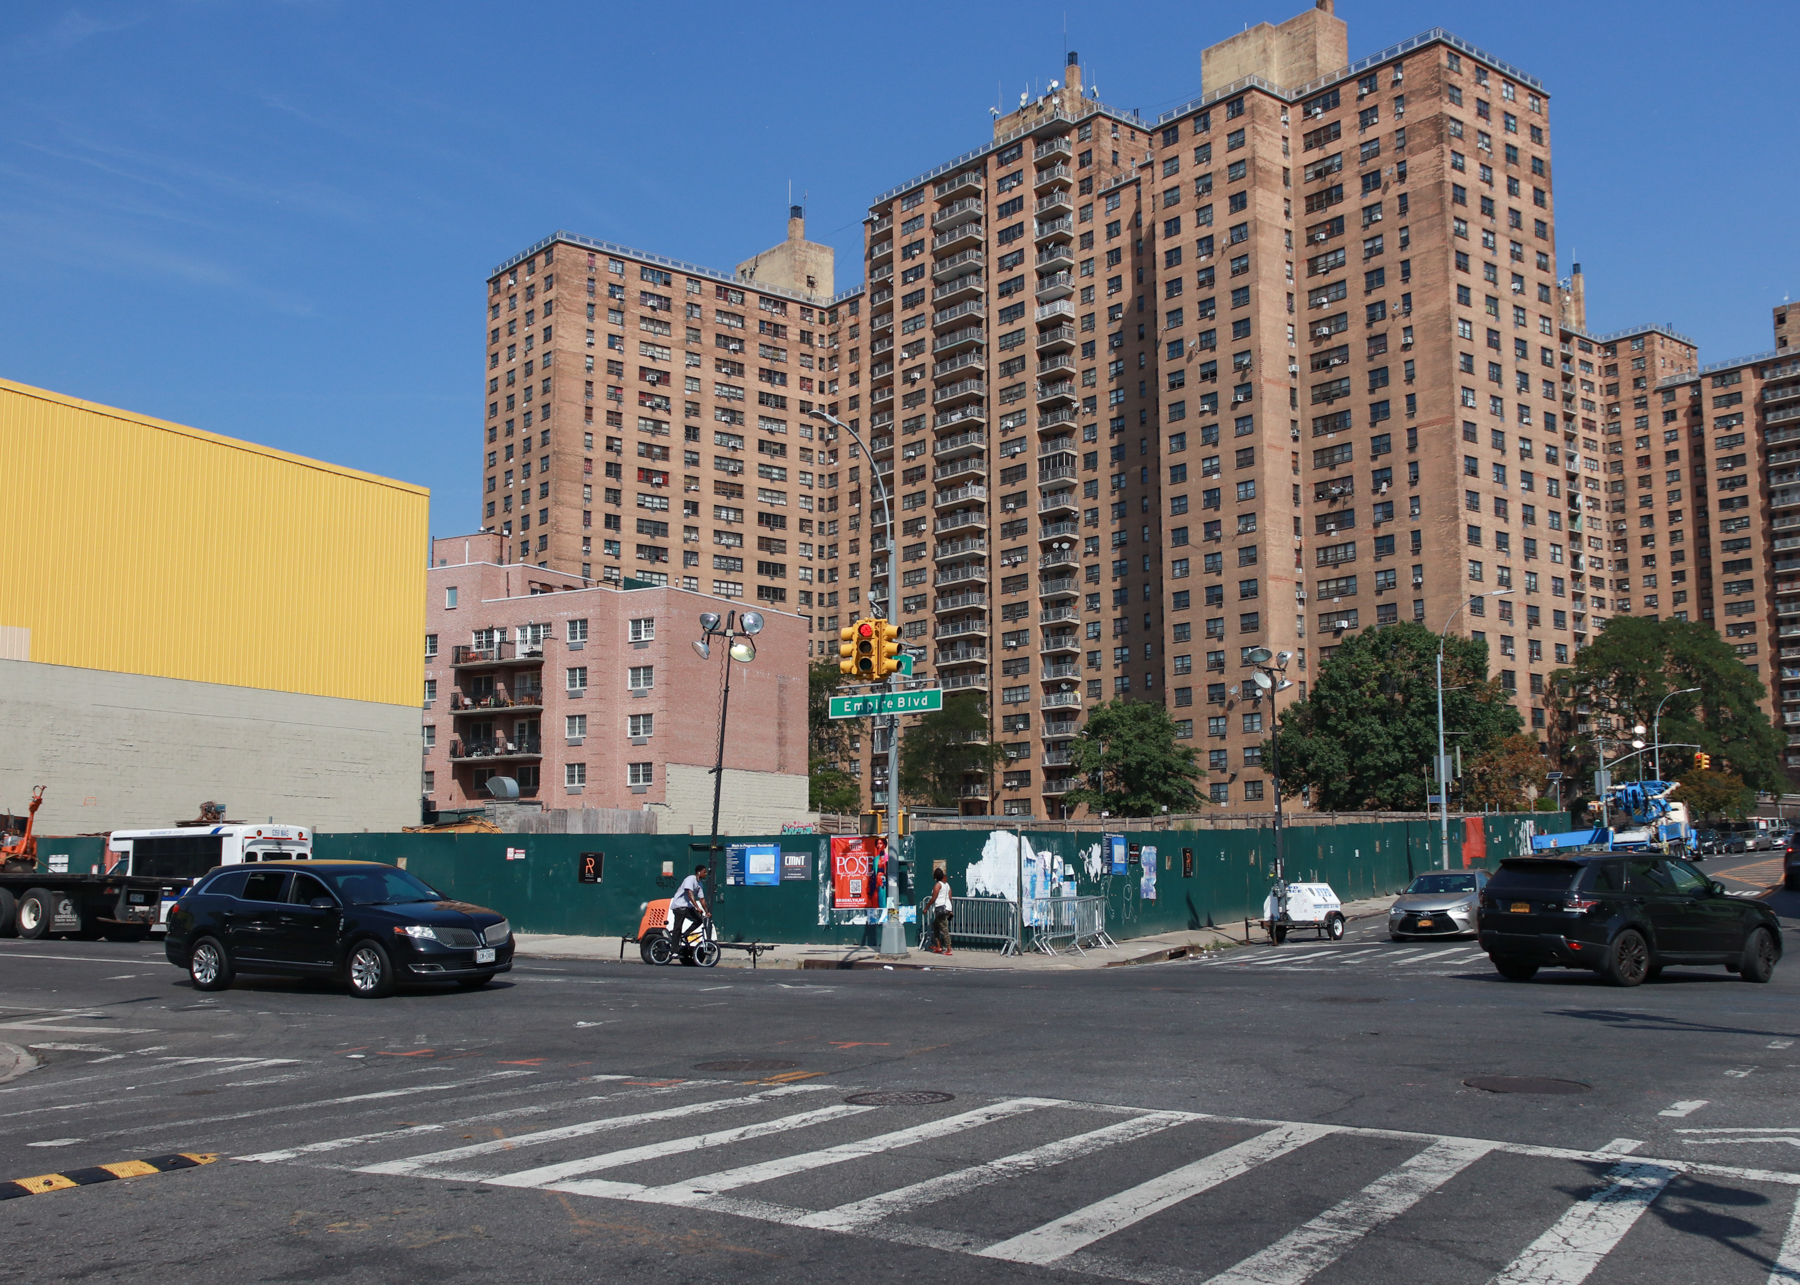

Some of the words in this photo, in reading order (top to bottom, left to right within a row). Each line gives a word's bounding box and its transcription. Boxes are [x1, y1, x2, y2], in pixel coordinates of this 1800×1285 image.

[844, 699, 894, 713] Empire
[897, 695, 928, 708] Blvd
[836, 856, 874, 874] POSE
[1315, 888, 1332, 897] NYPD
[58, 898, 73, 914] G
